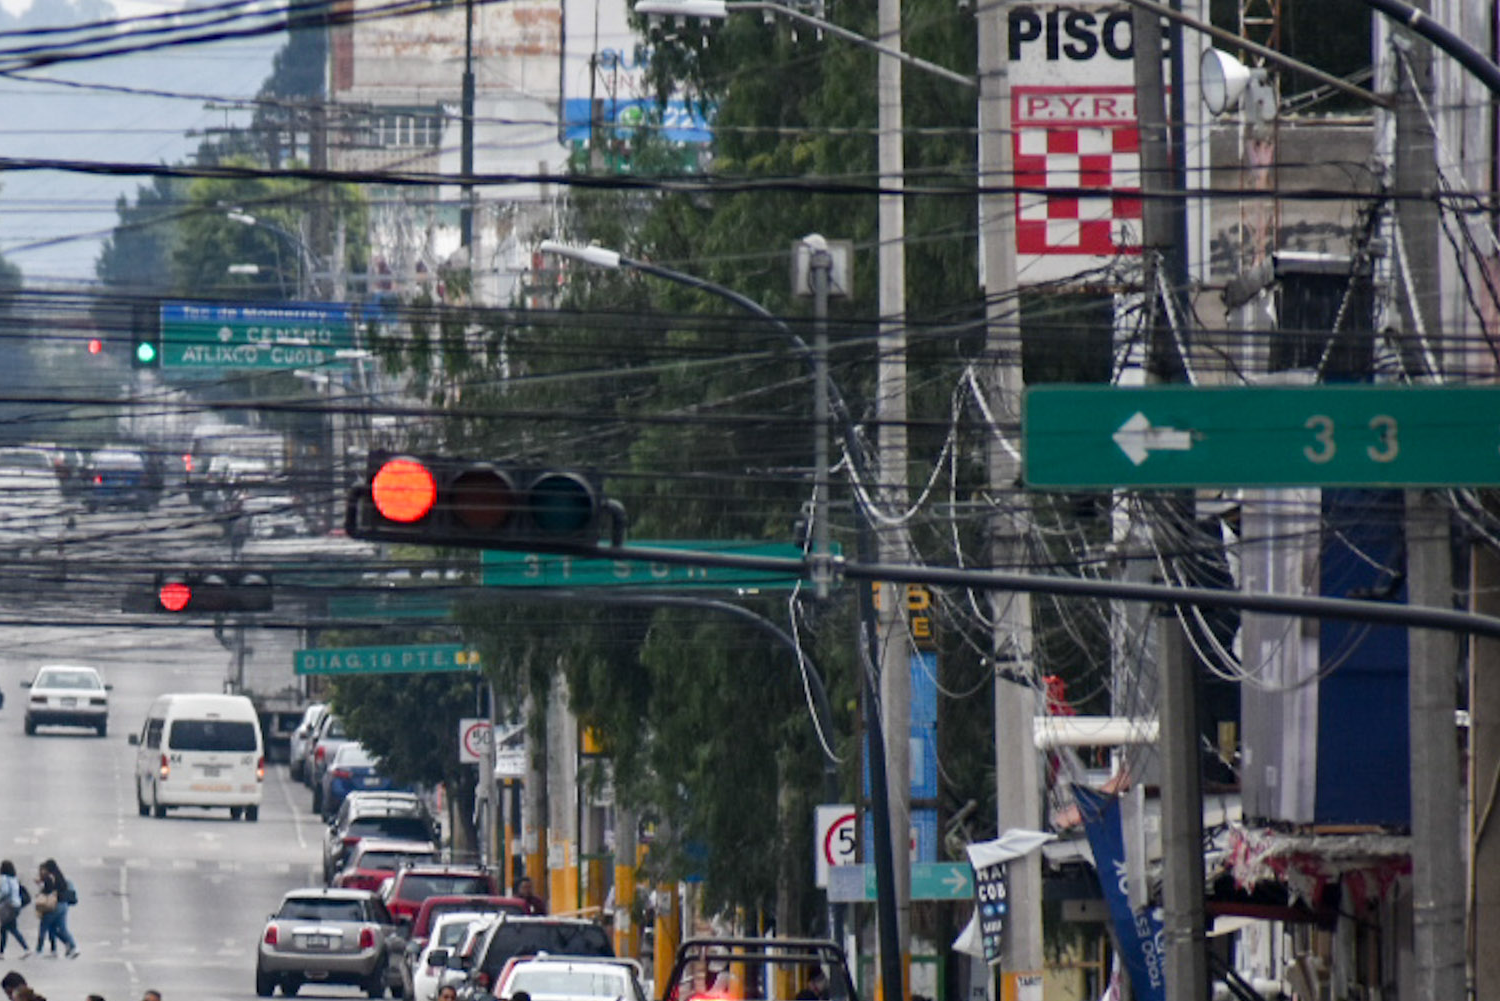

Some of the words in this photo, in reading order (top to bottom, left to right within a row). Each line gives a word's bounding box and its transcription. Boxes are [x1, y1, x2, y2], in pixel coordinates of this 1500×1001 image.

[1008, 11, 1170, 60] PISO
[1027, 98, 1138, 117] P.Y.R.
[182, 345, 258, 363] ATLIXCO
